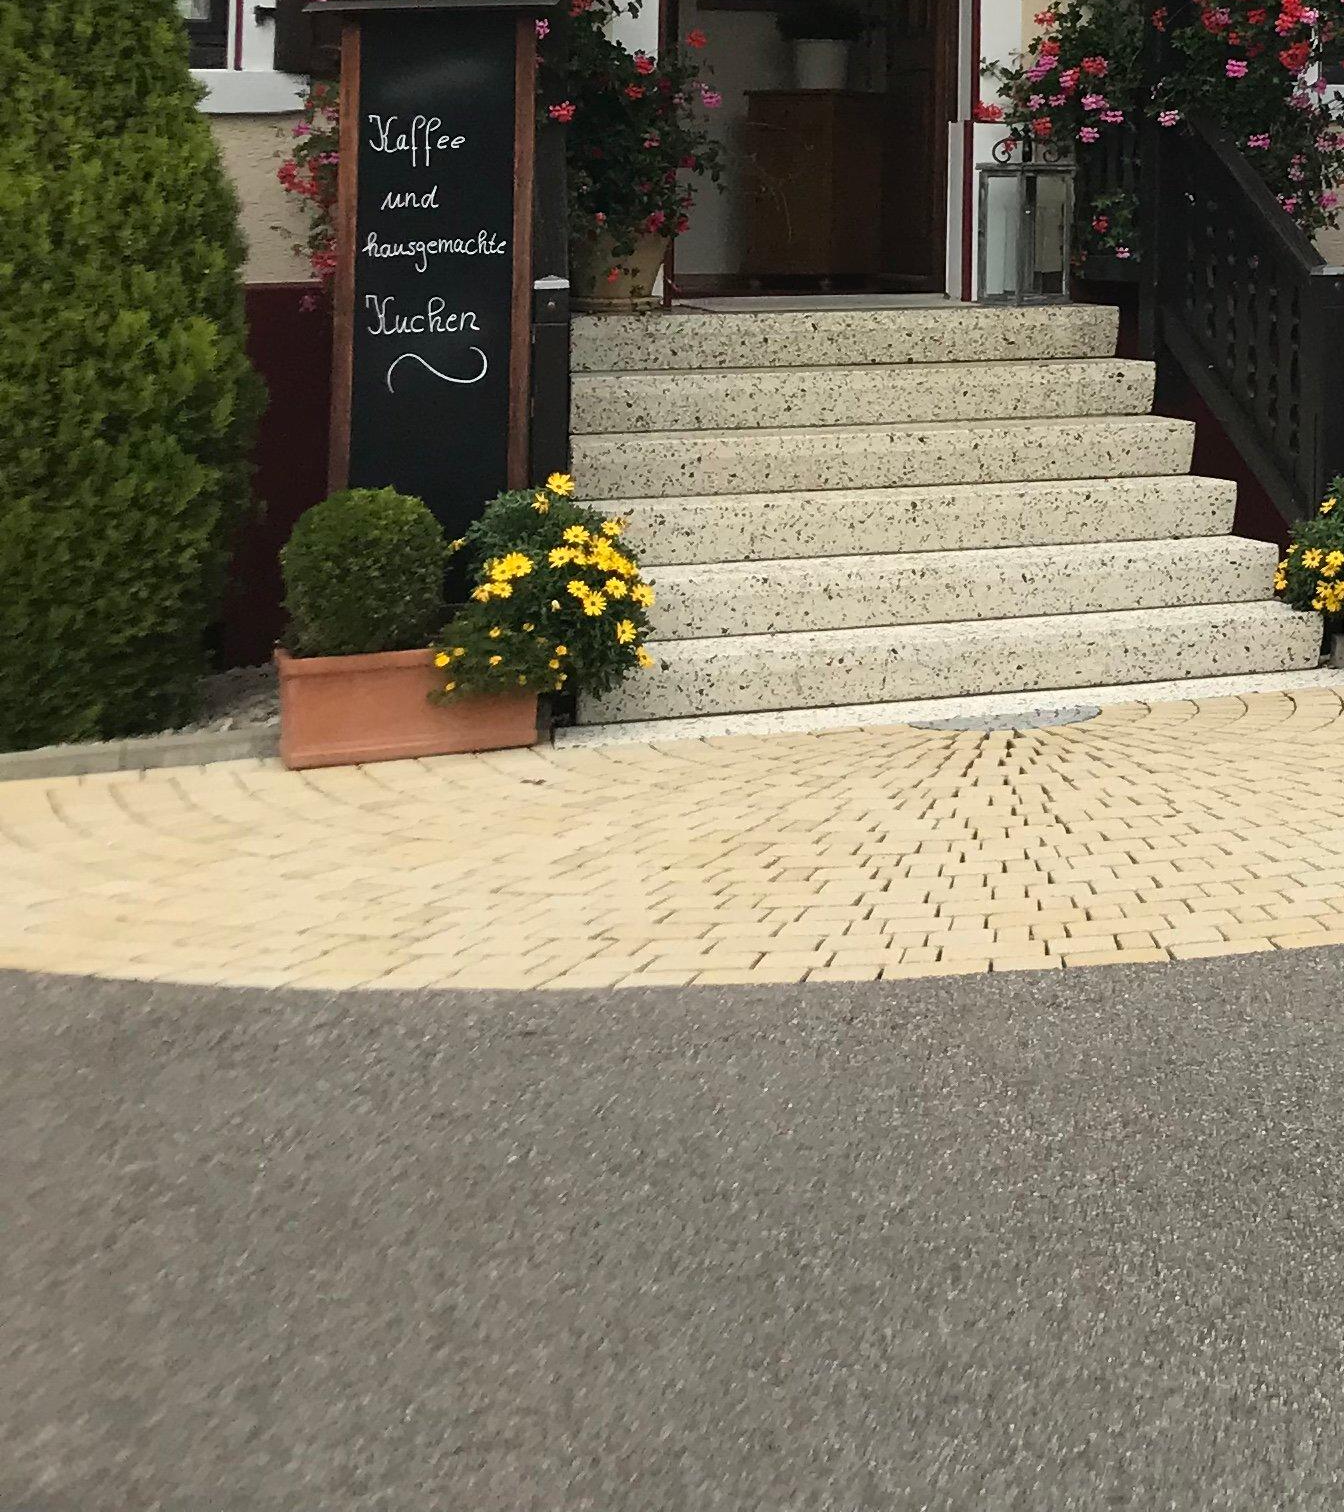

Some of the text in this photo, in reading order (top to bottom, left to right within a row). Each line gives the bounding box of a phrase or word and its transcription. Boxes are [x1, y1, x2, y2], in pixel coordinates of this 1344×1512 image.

[368, 114, 466, 167] Kaffee
[380, 184, 440, 211] und
[361, 229, 507, 273] hausgemachte
[365, 294, 481, 335] Kuchen
